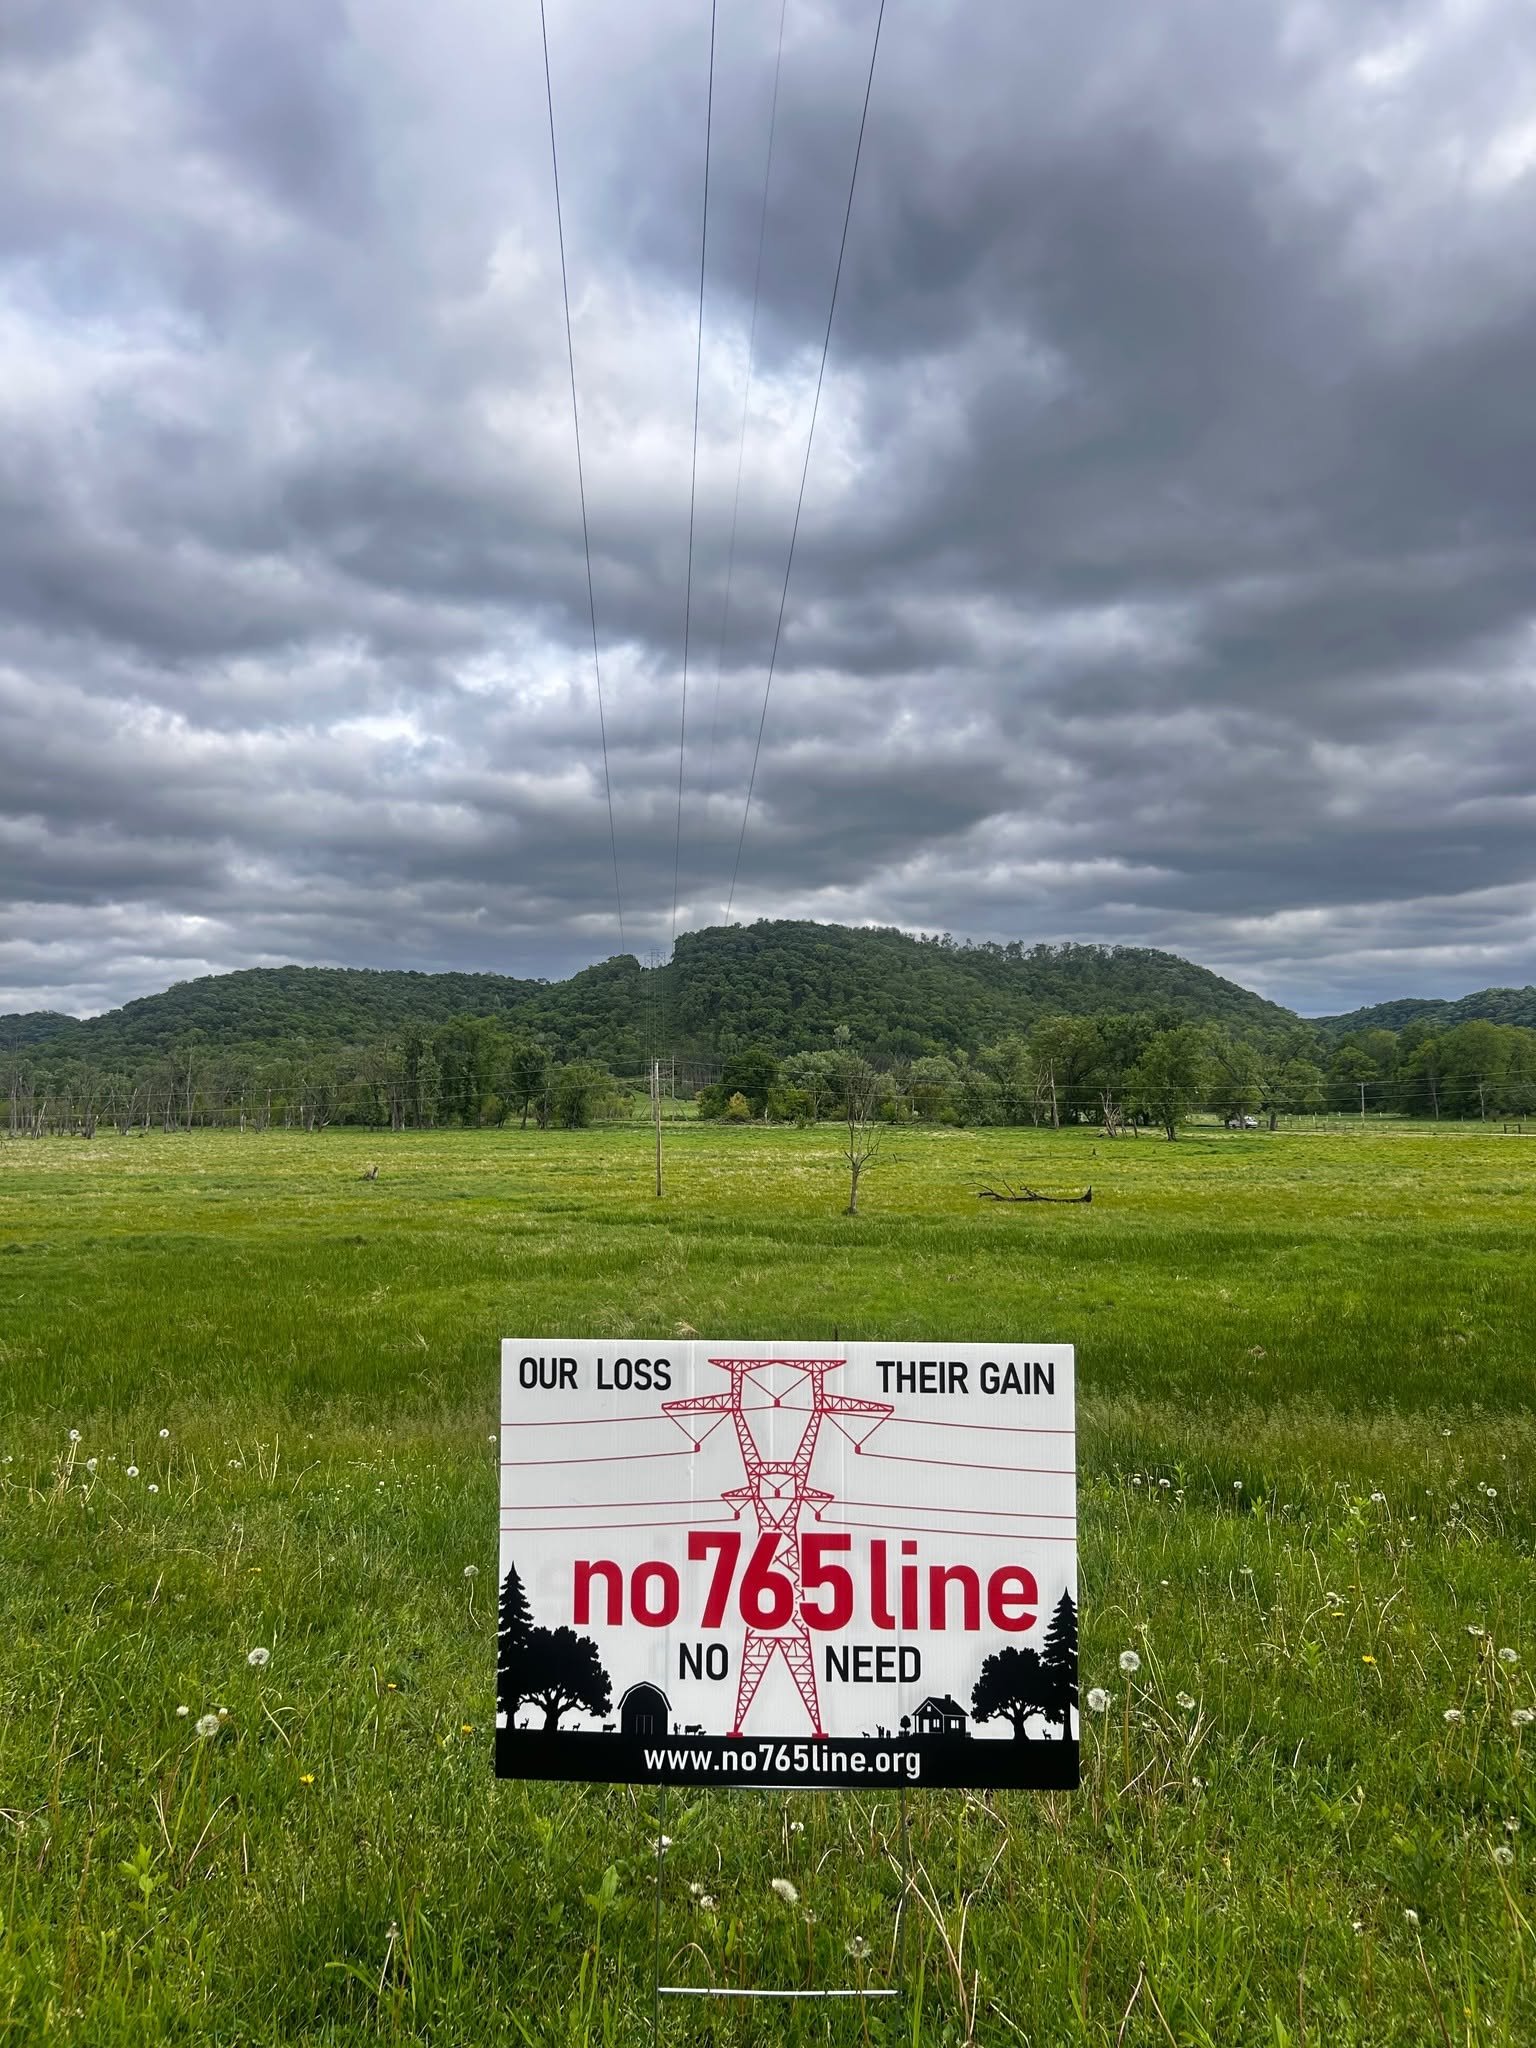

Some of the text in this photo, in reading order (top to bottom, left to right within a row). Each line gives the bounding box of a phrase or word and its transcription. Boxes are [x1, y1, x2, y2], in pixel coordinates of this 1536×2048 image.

[519, 1357, 672, 1391] OUR LOSS
[875, 1360, 1055, 1395] THEIR GAIN
[679, 1642, 921, 1683] NO NEED
[644, 1744, 921, 1780] www.no765line.org
